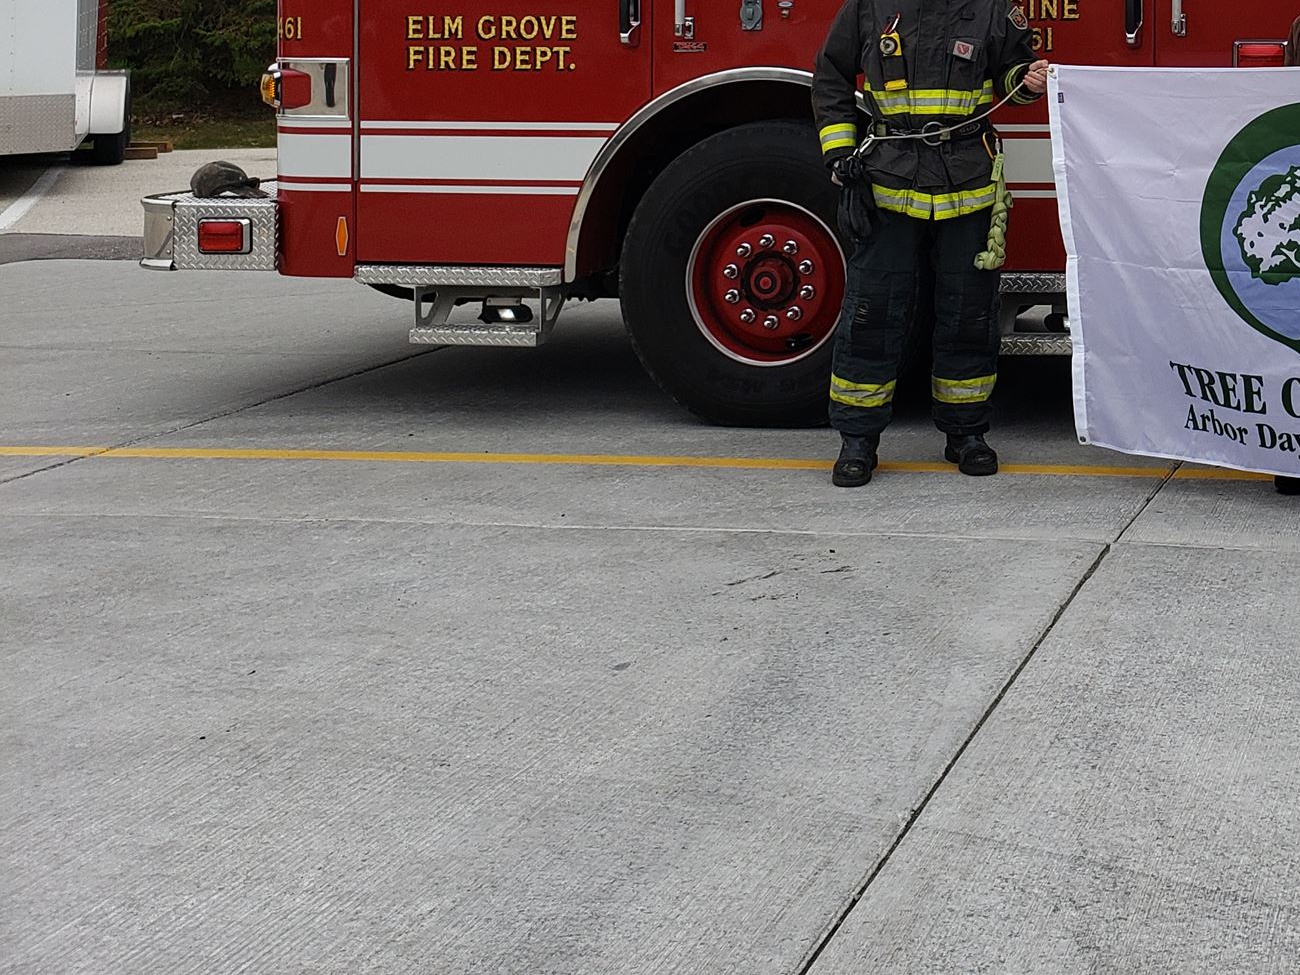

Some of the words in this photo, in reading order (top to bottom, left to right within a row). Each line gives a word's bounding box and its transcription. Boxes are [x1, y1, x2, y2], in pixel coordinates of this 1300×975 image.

[406, 15, 464, 40] ELM
[476, 15, 578, 40] GROVE
[1031, 27, 1053, 51] 61
[407, 46, 478, 71] FIRE
[492, 46, 577, 71] DEPT.
[1169, 361, 1268, 415] TREE
[1184, 403, 1249, 446] Arbor
